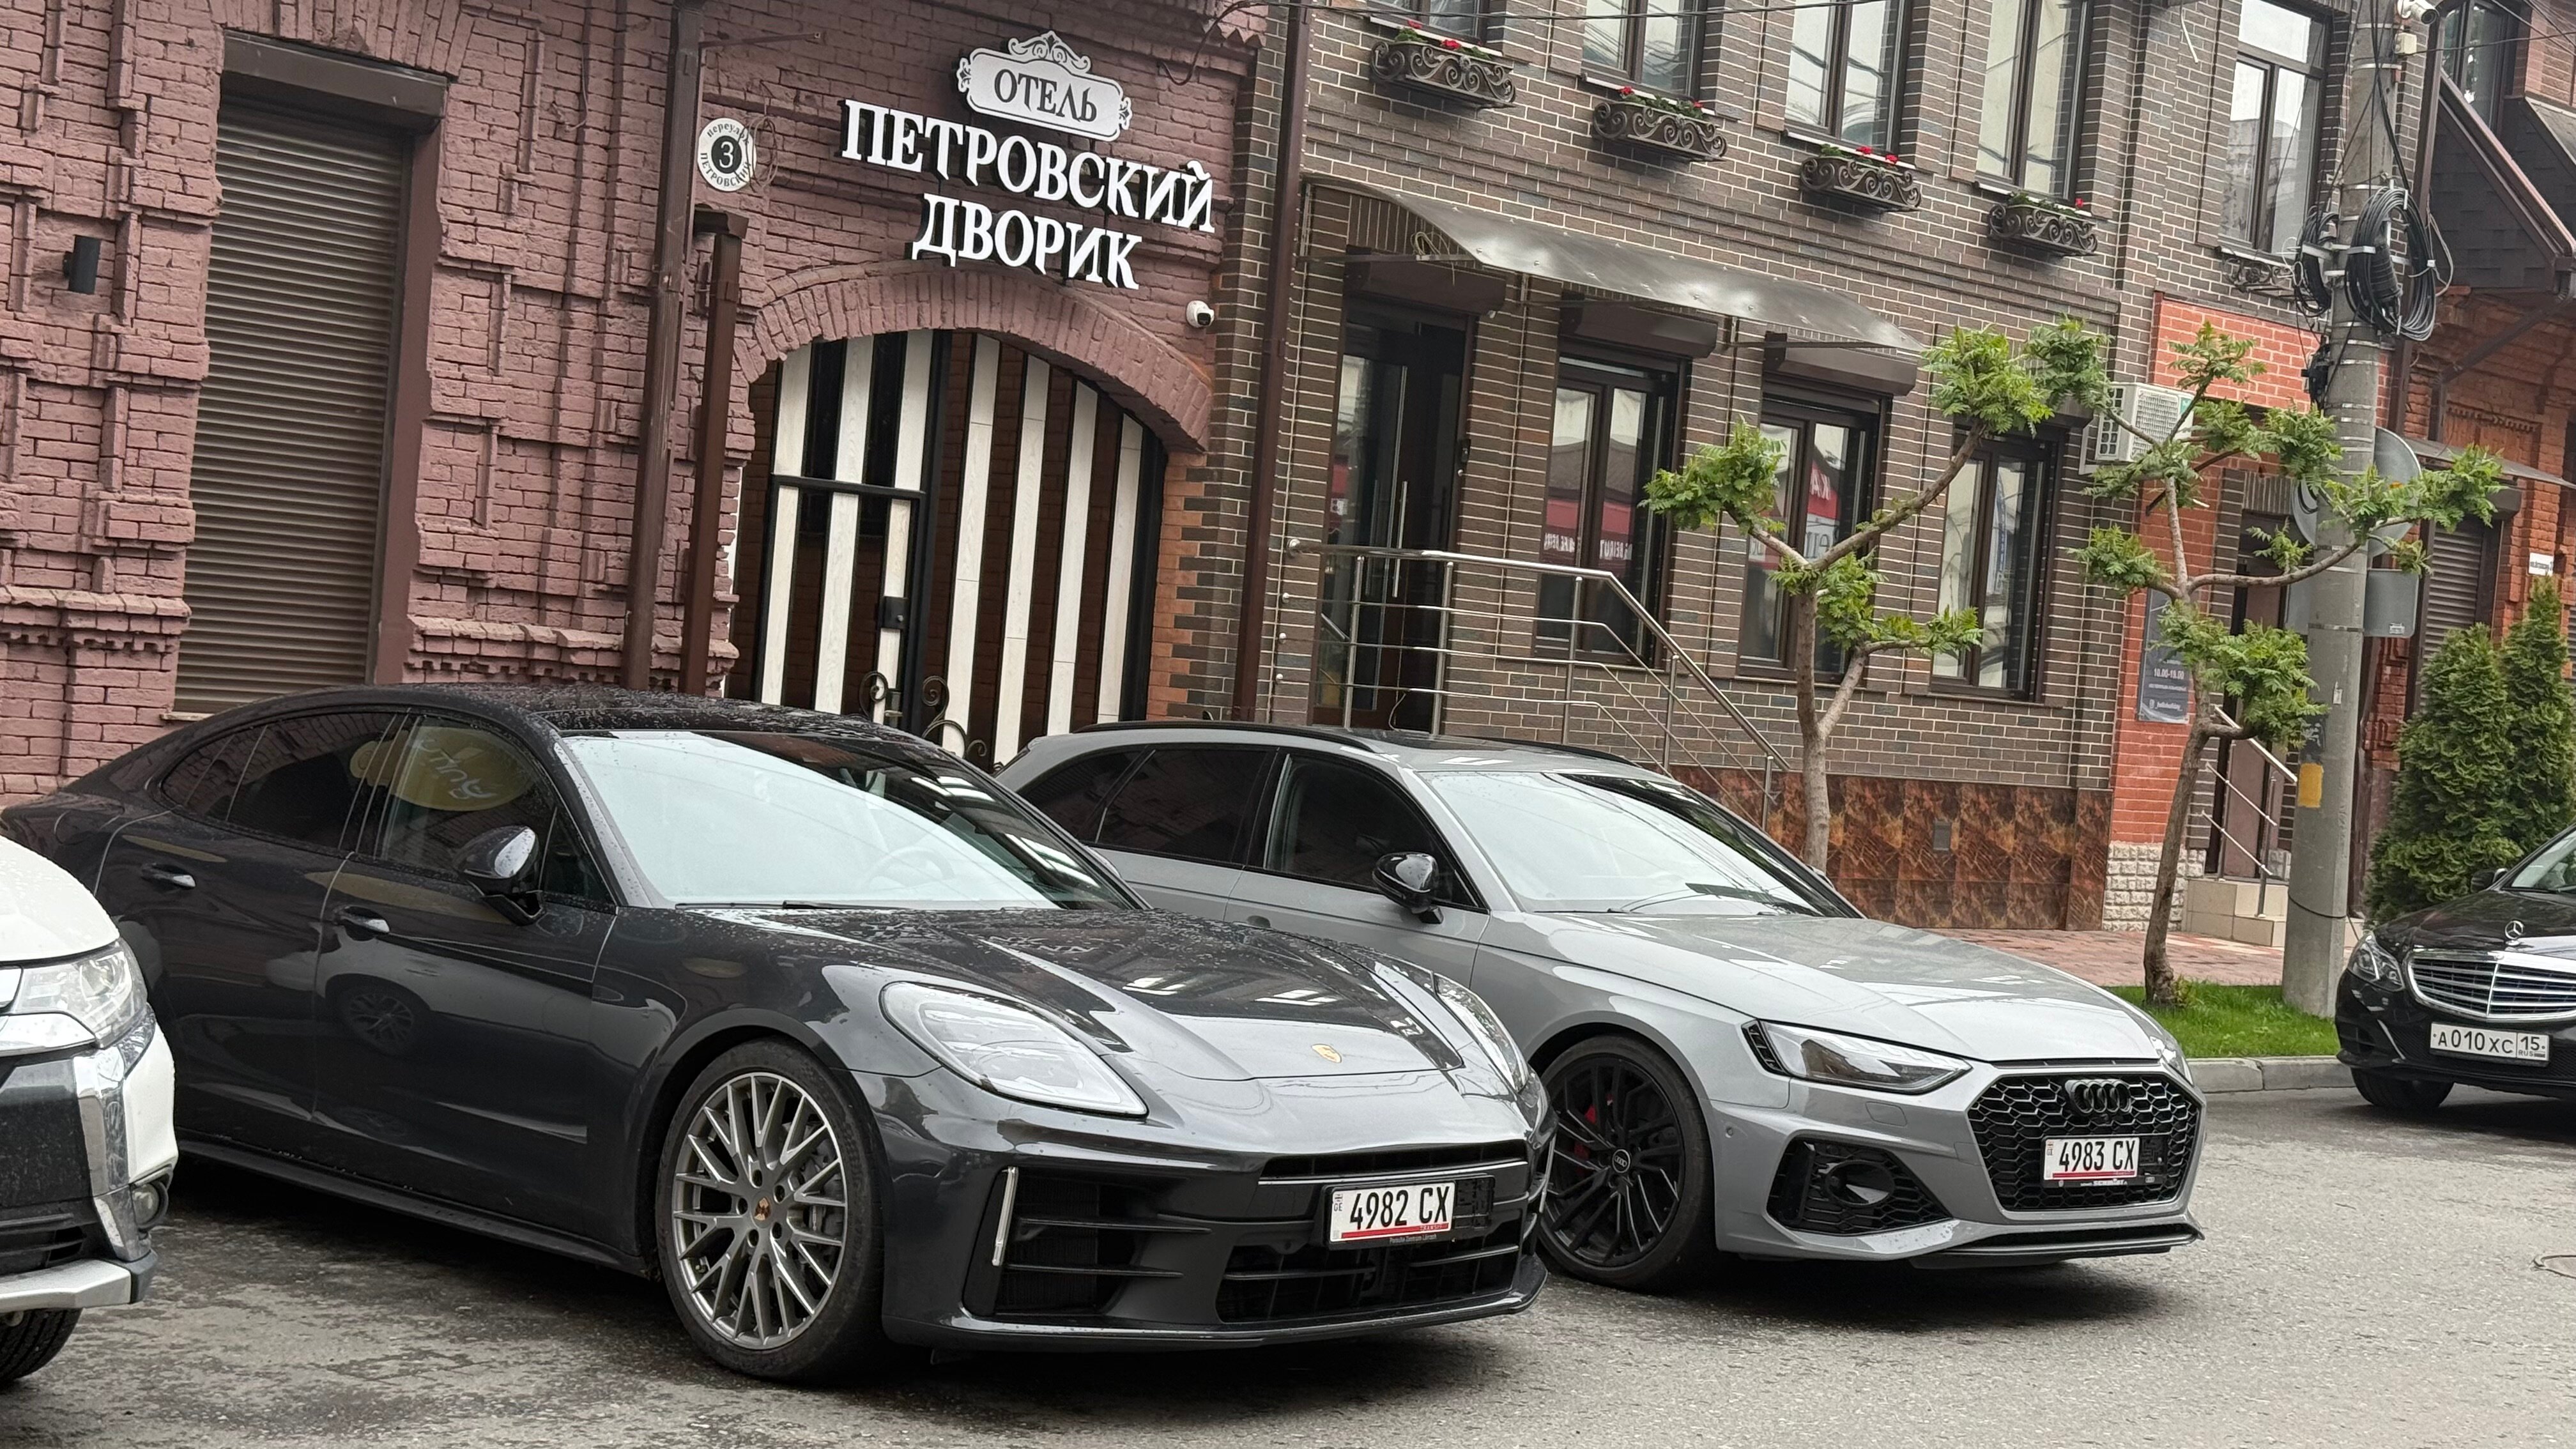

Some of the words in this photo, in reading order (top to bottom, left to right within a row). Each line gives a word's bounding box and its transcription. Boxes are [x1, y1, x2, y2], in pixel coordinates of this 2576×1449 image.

[993, 68, 1098, 123] ОТЕЛЬ
[719, 141, 734, 169] 3
[841, 99, 1215, 233] ПЕТРОВСКИЙ
[911, 194, 1142, 289] ДВОРИК
[2520, 1036, 2540, 1051] 15
[2058, 1141, 2105, 1172] 4983
[2113, 1140, 2136, 1170] CX
[1333, 1202, 1343, 1212] GE
[1349, 1190, 1409, 1230] 4982
[1419, 1186, 1450, 1223] CX
